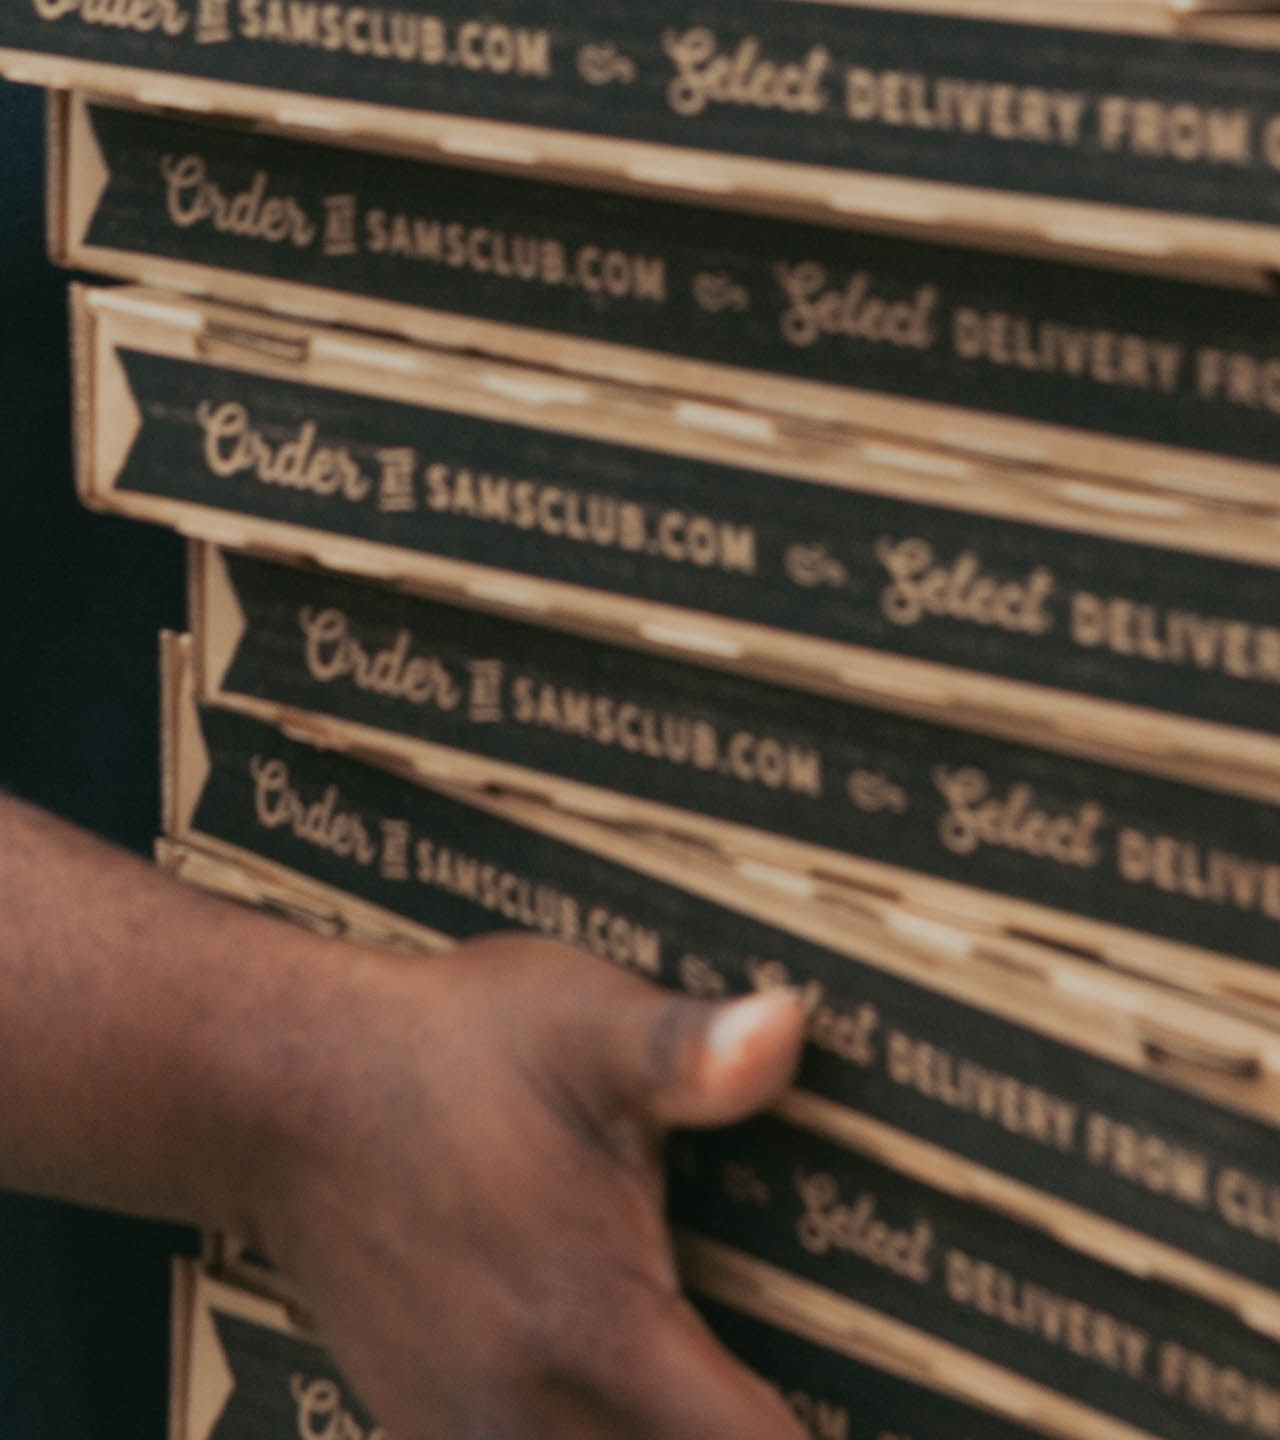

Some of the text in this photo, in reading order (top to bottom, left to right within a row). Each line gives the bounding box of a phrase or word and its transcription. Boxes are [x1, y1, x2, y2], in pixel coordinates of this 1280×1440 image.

[662, 26, 830, 116] Select
[844, 71, 1084, 144] DELIVERY
[1099, 98, 1249, 163] FROM
[161, 154, 314, 247] Order
[366, 210, 667, 302] SAMSCLUB.COM
[776, 261, 936, 348] Select
[952, 308, 1184, 390] DELIVERY
[198, 402, 370, 501] Order
[426, 465, 757, 573] SAMSCLUB.COM
[875, 536, 1055, 636] Select
[300, 607, 460, 712] Order
[511, 677, 822, 798] SAMSCLUB.COM
[933, 765, 1104, 869] Select
[251, 756, 375, 867] Order
[417, 838, 661, 975] SAMSCLUB.COM
[887, 1029, 1078, 1151] DELIVERY
[1087, 1110, 1208, 1207] FROM
[793, 1167, 934, 1283] Select
[946, 1248, 1149, 1379] DELIVERY
